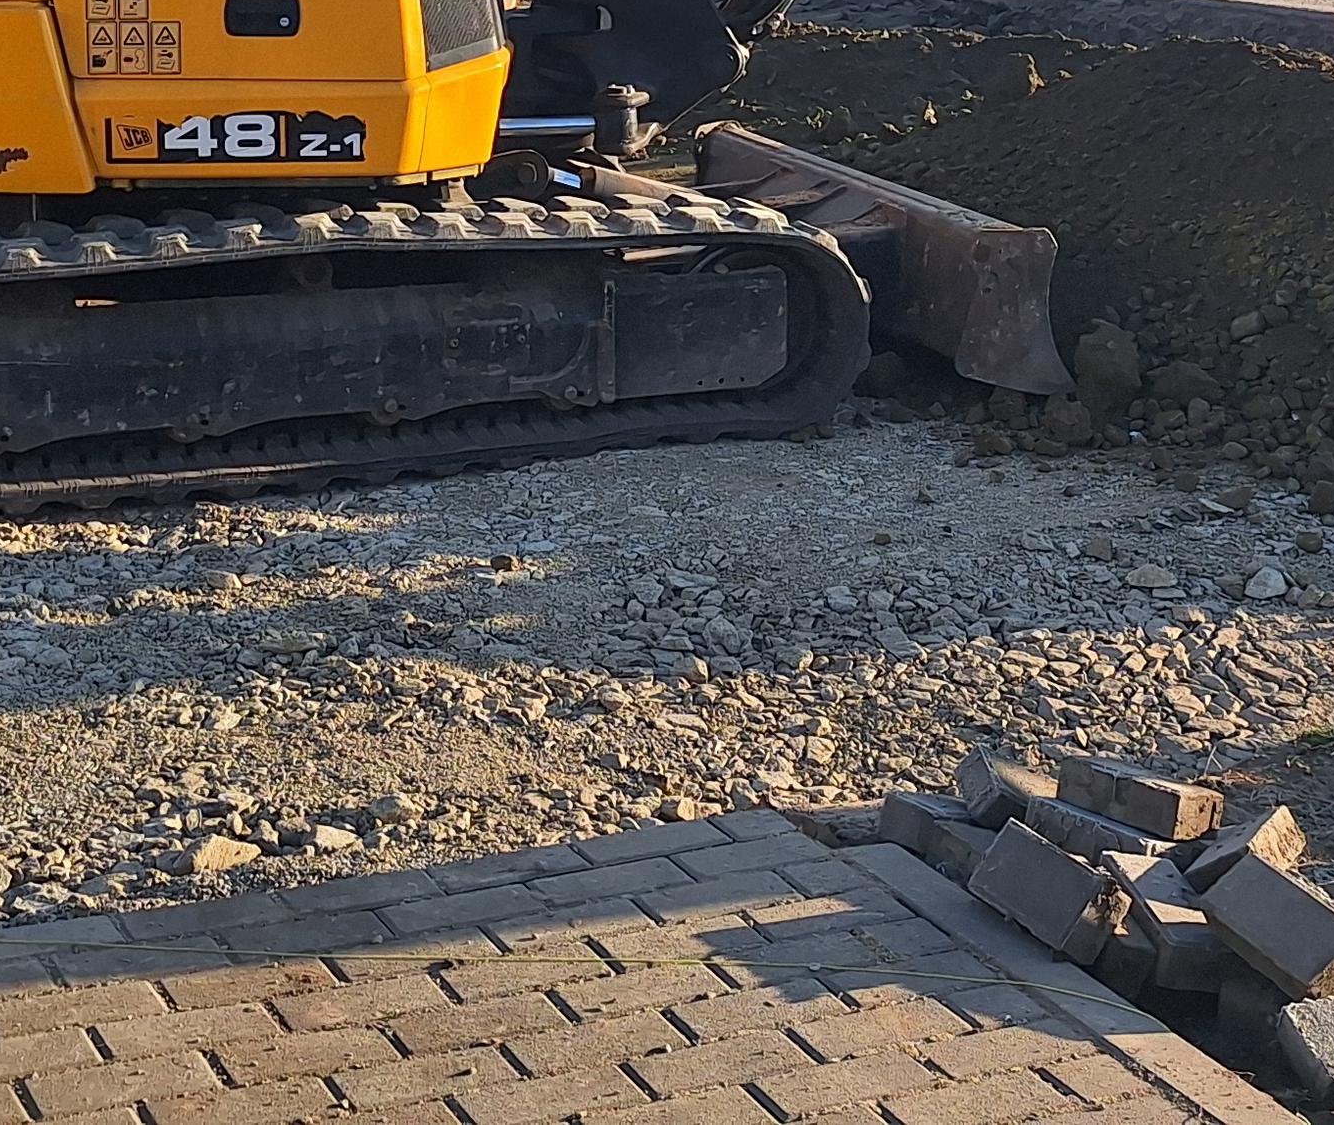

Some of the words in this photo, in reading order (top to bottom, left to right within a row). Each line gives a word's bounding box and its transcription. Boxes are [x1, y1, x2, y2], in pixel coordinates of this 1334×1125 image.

[122, 127, 152, 149] JCB
[164, 114, 276, 158] 48
[299, 132, 362, 157] Z-1
